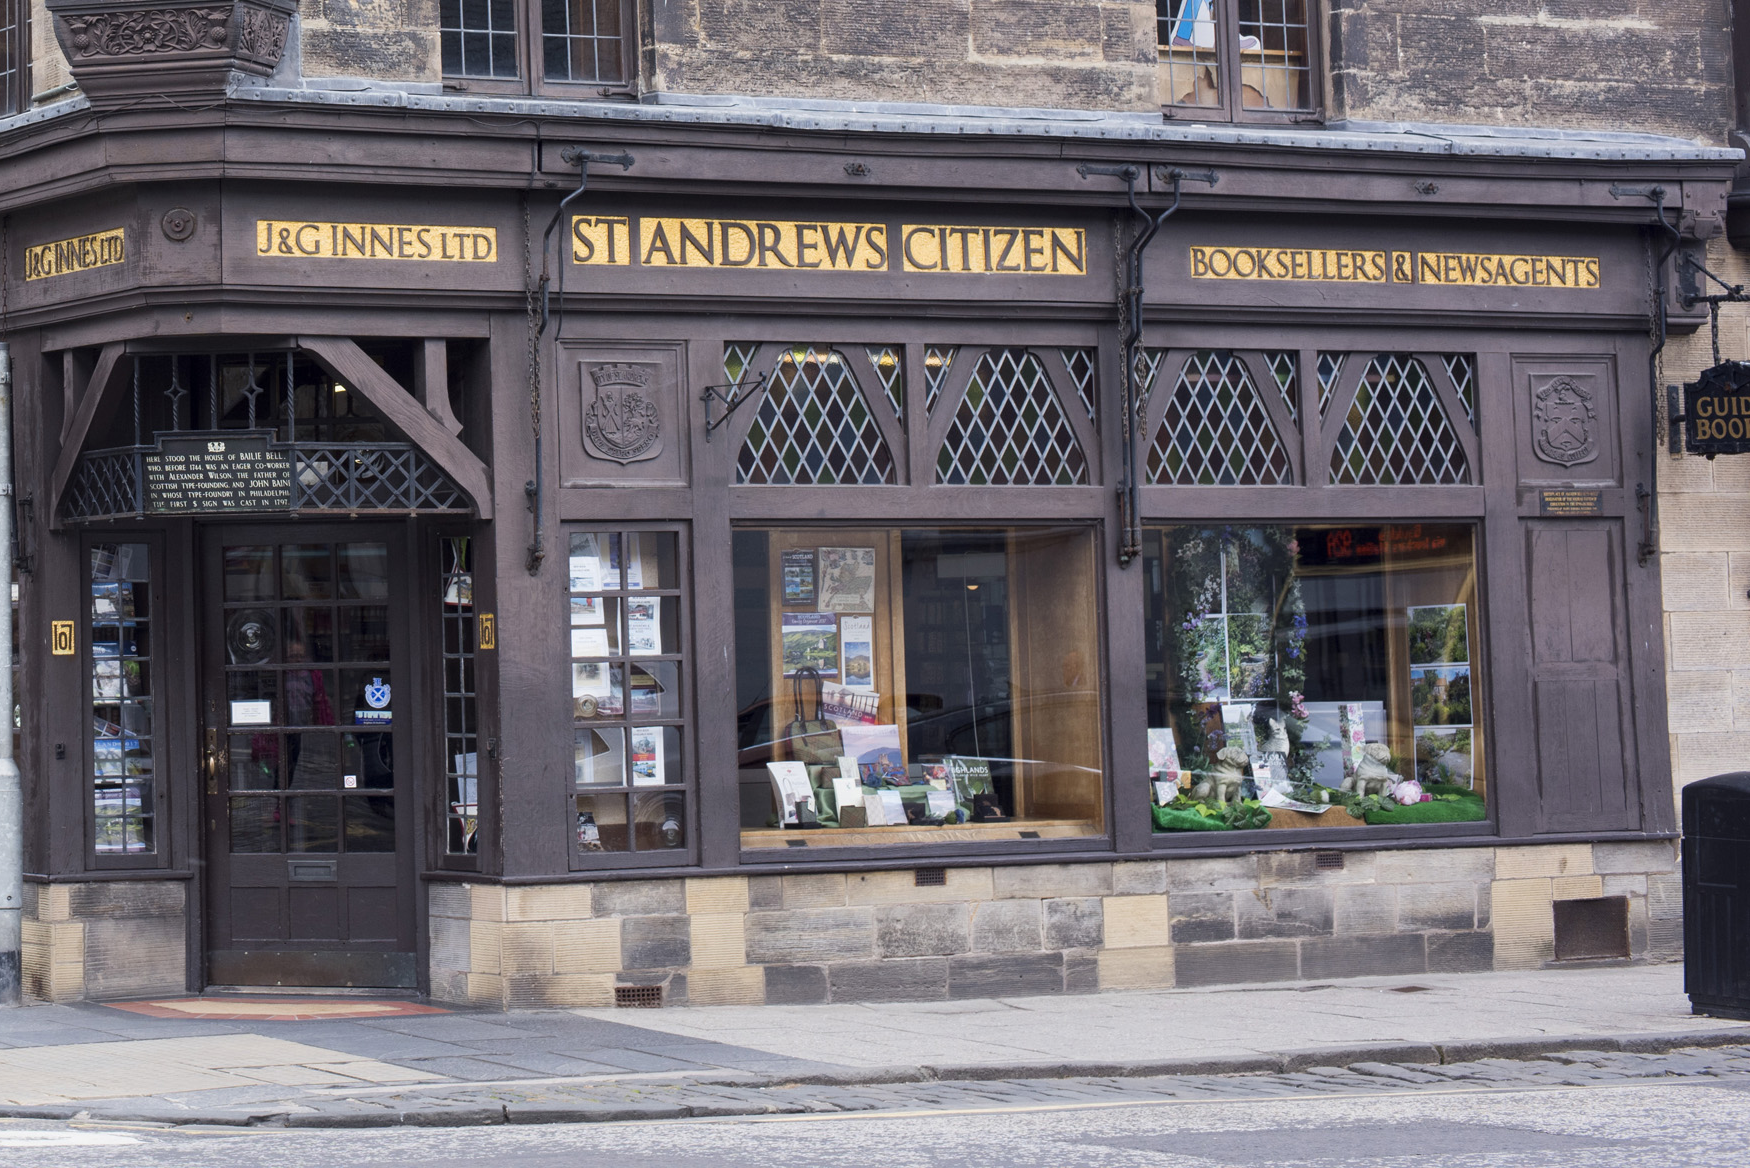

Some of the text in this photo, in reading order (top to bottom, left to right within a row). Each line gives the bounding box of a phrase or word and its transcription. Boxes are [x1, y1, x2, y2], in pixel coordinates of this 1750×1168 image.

[259, 223, 493, 260] J&G INNES LTD
[573, 217, 1086, 274] ST ANDREWS CITIZEN
[26, 235, 124, 278] J&G INNES LTD
[1192, 247, 1599, 287] BOOKSELLERS & NEWSAGENTS
[165, 455, 186, 463] STOOD
[204, 454, 224, 462] HOUSE
[239, 452, 262, 461] BAILIE
[164, 464, 186, 472] BEFORE
[232, 462, 251, 470] EAGER
[254, 462, 291, 470] CO-WORKER
[249, 479, 269, 488] JOHN
[187, 491, 233, 499] TYPE-FOUNDRY
[238, 490, 246, 498] IN
[202, 500, 218, 508] SIGN
[240, 499, 257, 507] CAST
[261, 499, 270, 507] IN
[823, 703, 863, 718] SCOTLAND
